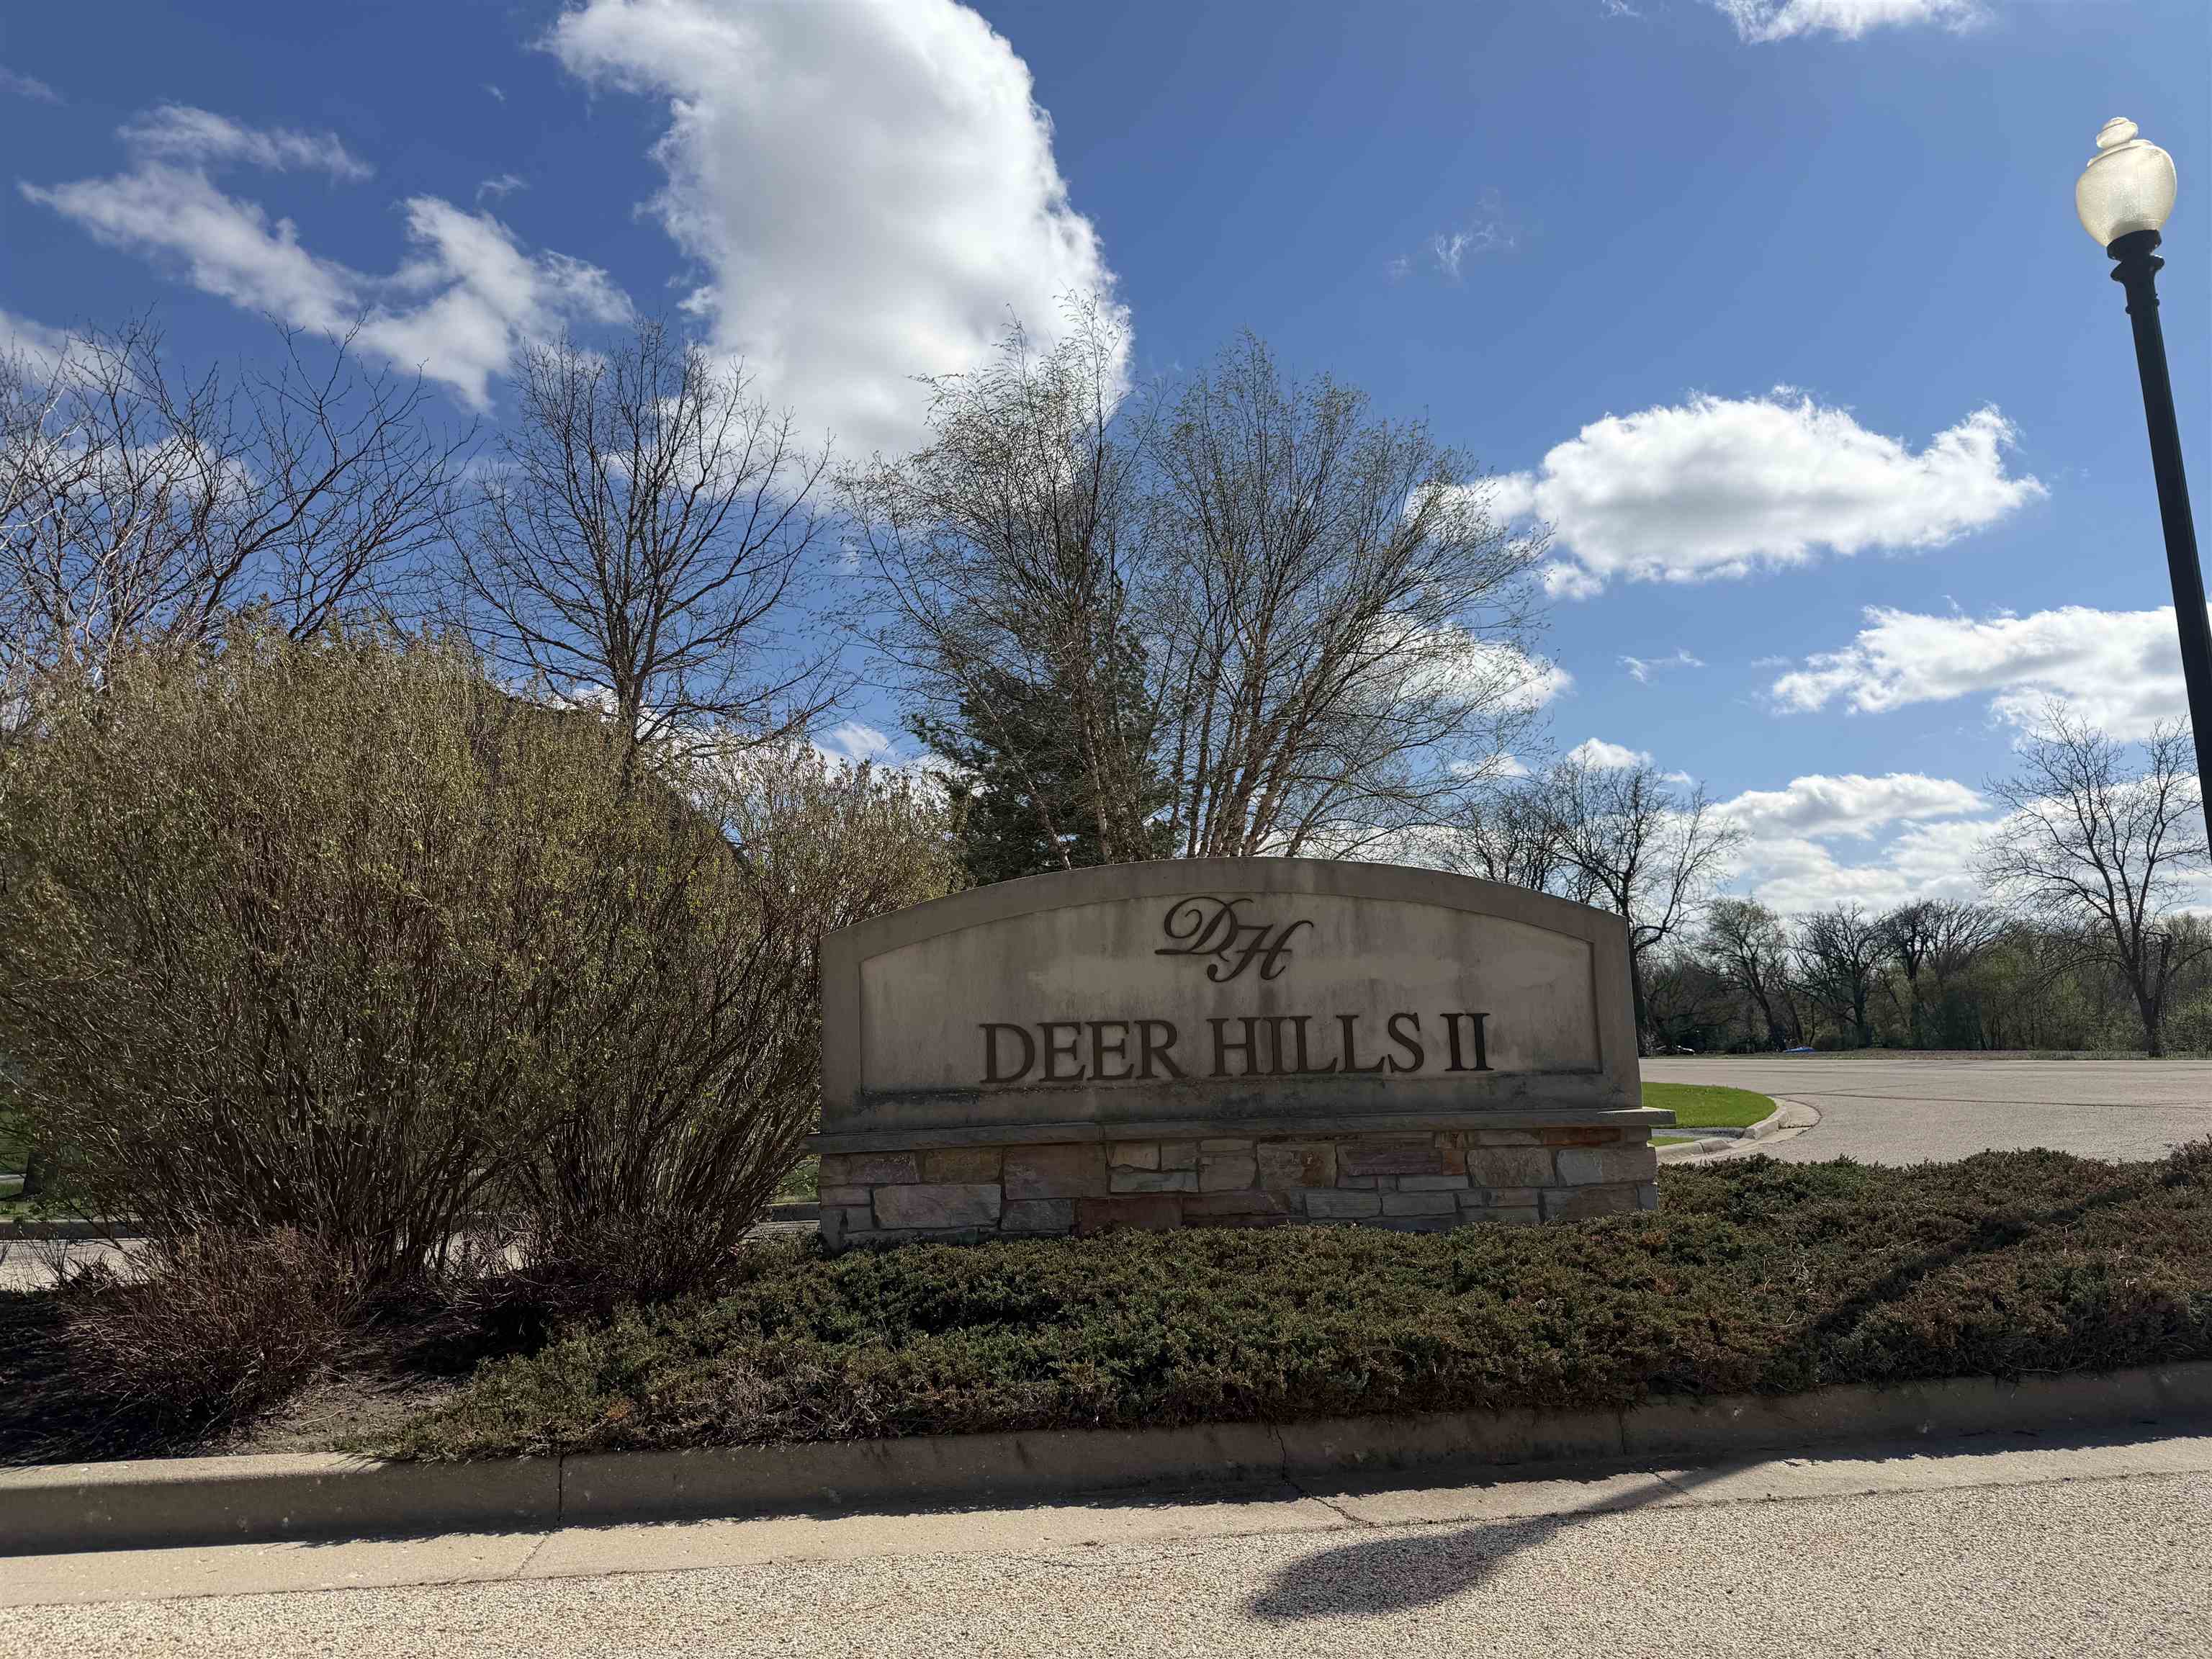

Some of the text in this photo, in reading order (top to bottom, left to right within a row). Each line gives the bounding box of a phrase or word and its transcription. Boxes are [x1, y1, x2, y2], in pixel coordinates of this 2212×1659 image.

[1154, 896, 1313, 983] DH
[978, 1012, 1491, 1084] DEER HILLS II
